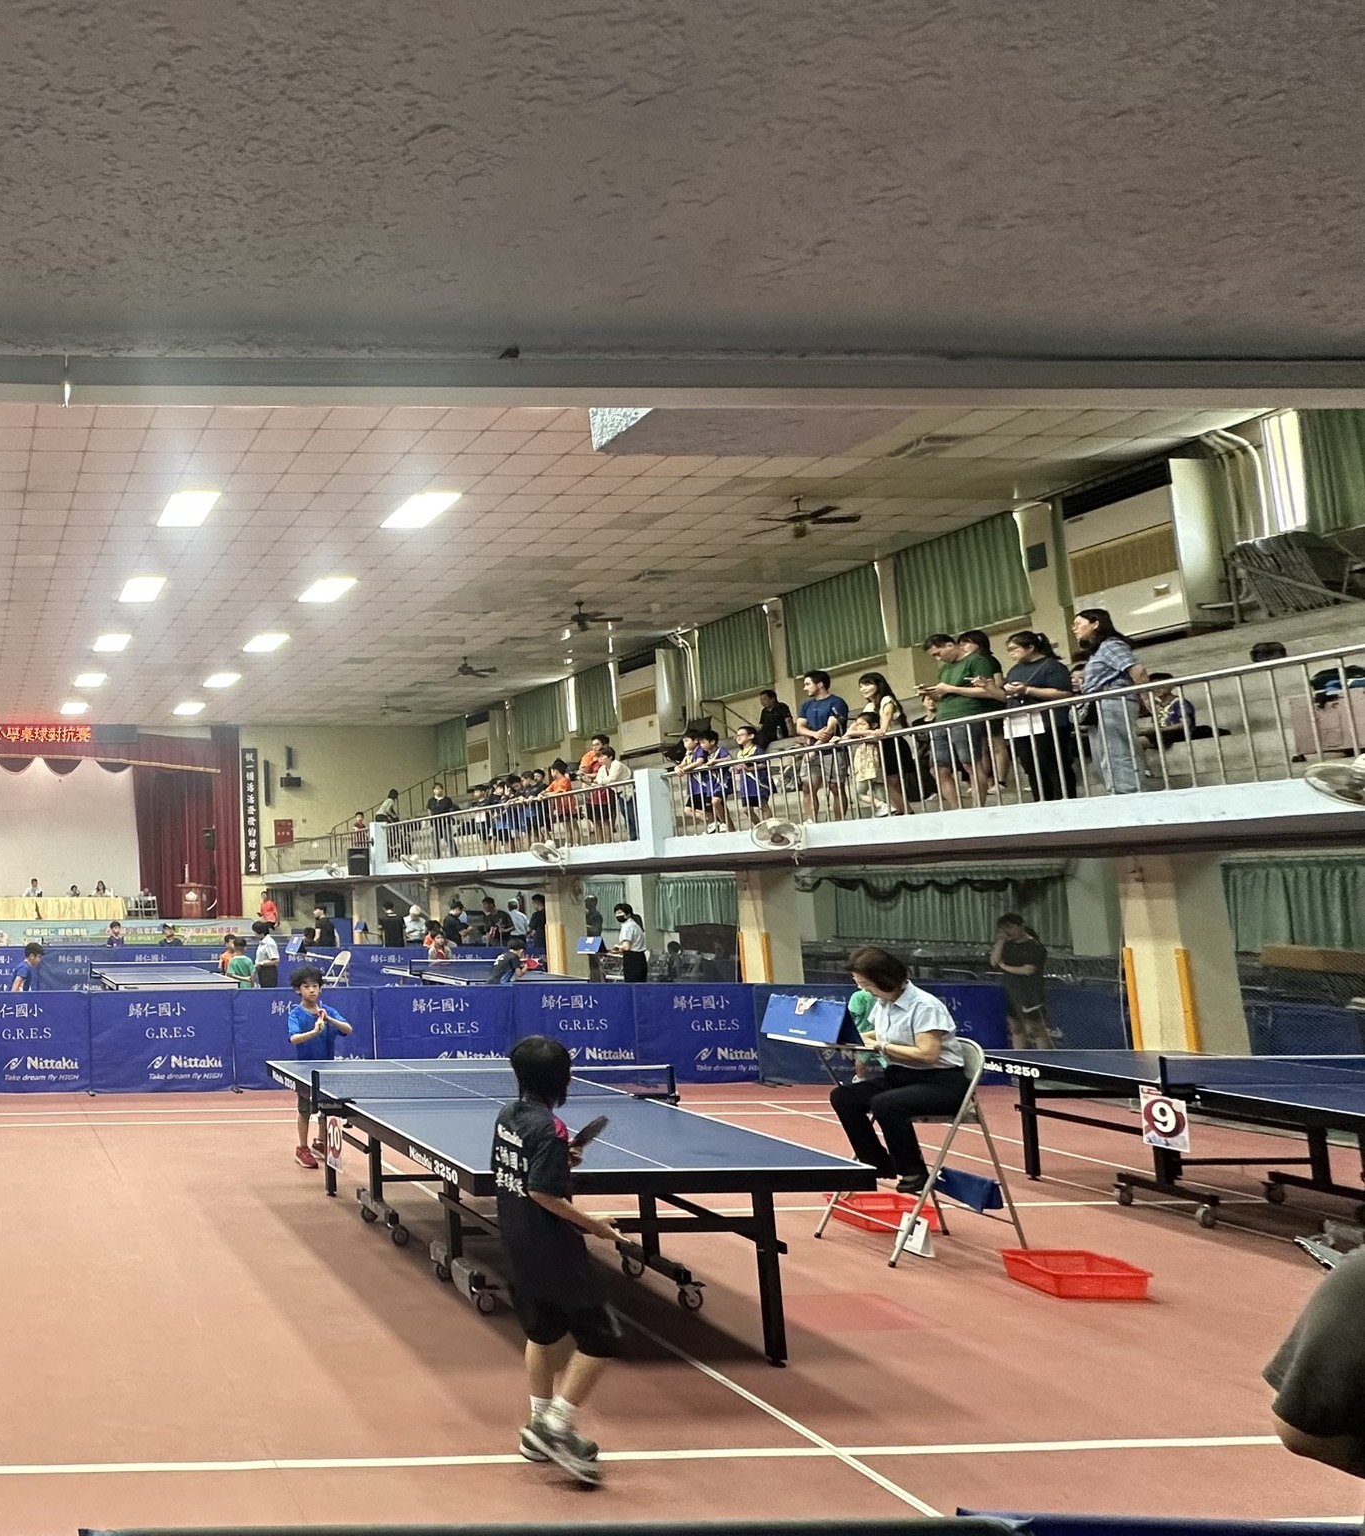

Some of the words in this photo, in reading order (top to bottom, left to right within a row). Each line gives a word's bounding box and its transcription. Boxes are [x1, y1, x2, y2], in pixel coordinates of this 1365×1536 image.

[58, 955, 91, 963] 歸仁國小
[371, 954, 404, 963] 歸仁國小
[271, 1000, 296, 1016] 歸仁
[412, 998, 469, 1014] 歸仁國小
[541, 994, 598, 1010] 歸仁國小
[673, 995, 730, 1011] 歸仁國小
[128, 1002, 186, 1018] 歸仁國小
[430, 1021, 479, 1035] G.R.E.S
[559, 1018, 608, 1031] G.R.E.S
[691, 1018, 739, 1032] G.R.E.S
[2, 1027, 52, 1040] G.R.E.S
[145, 1026, 195, 1039] G.R.E.S
[585, 1046, 635, 1060] Nittaku
[717, 1046, 758, 1060] Nittak
[26, 1056, 79, 1070] Nittaku
[170, 1054, 223, 1068] Nittaku
[47, 1073, 57, 1082] fly
[166, 1072, 190, 1080] dream
[191, 1072, 202, 1080] fly
[1005, 1063, 1040, 1078] 3250
[1151, 1101, 1177, 1133] 9
[328, 1123, 341, 1151] 10
[409, 1144, 433, 1172] Nittaku
[433, 1159, 458, 1185] 3250
